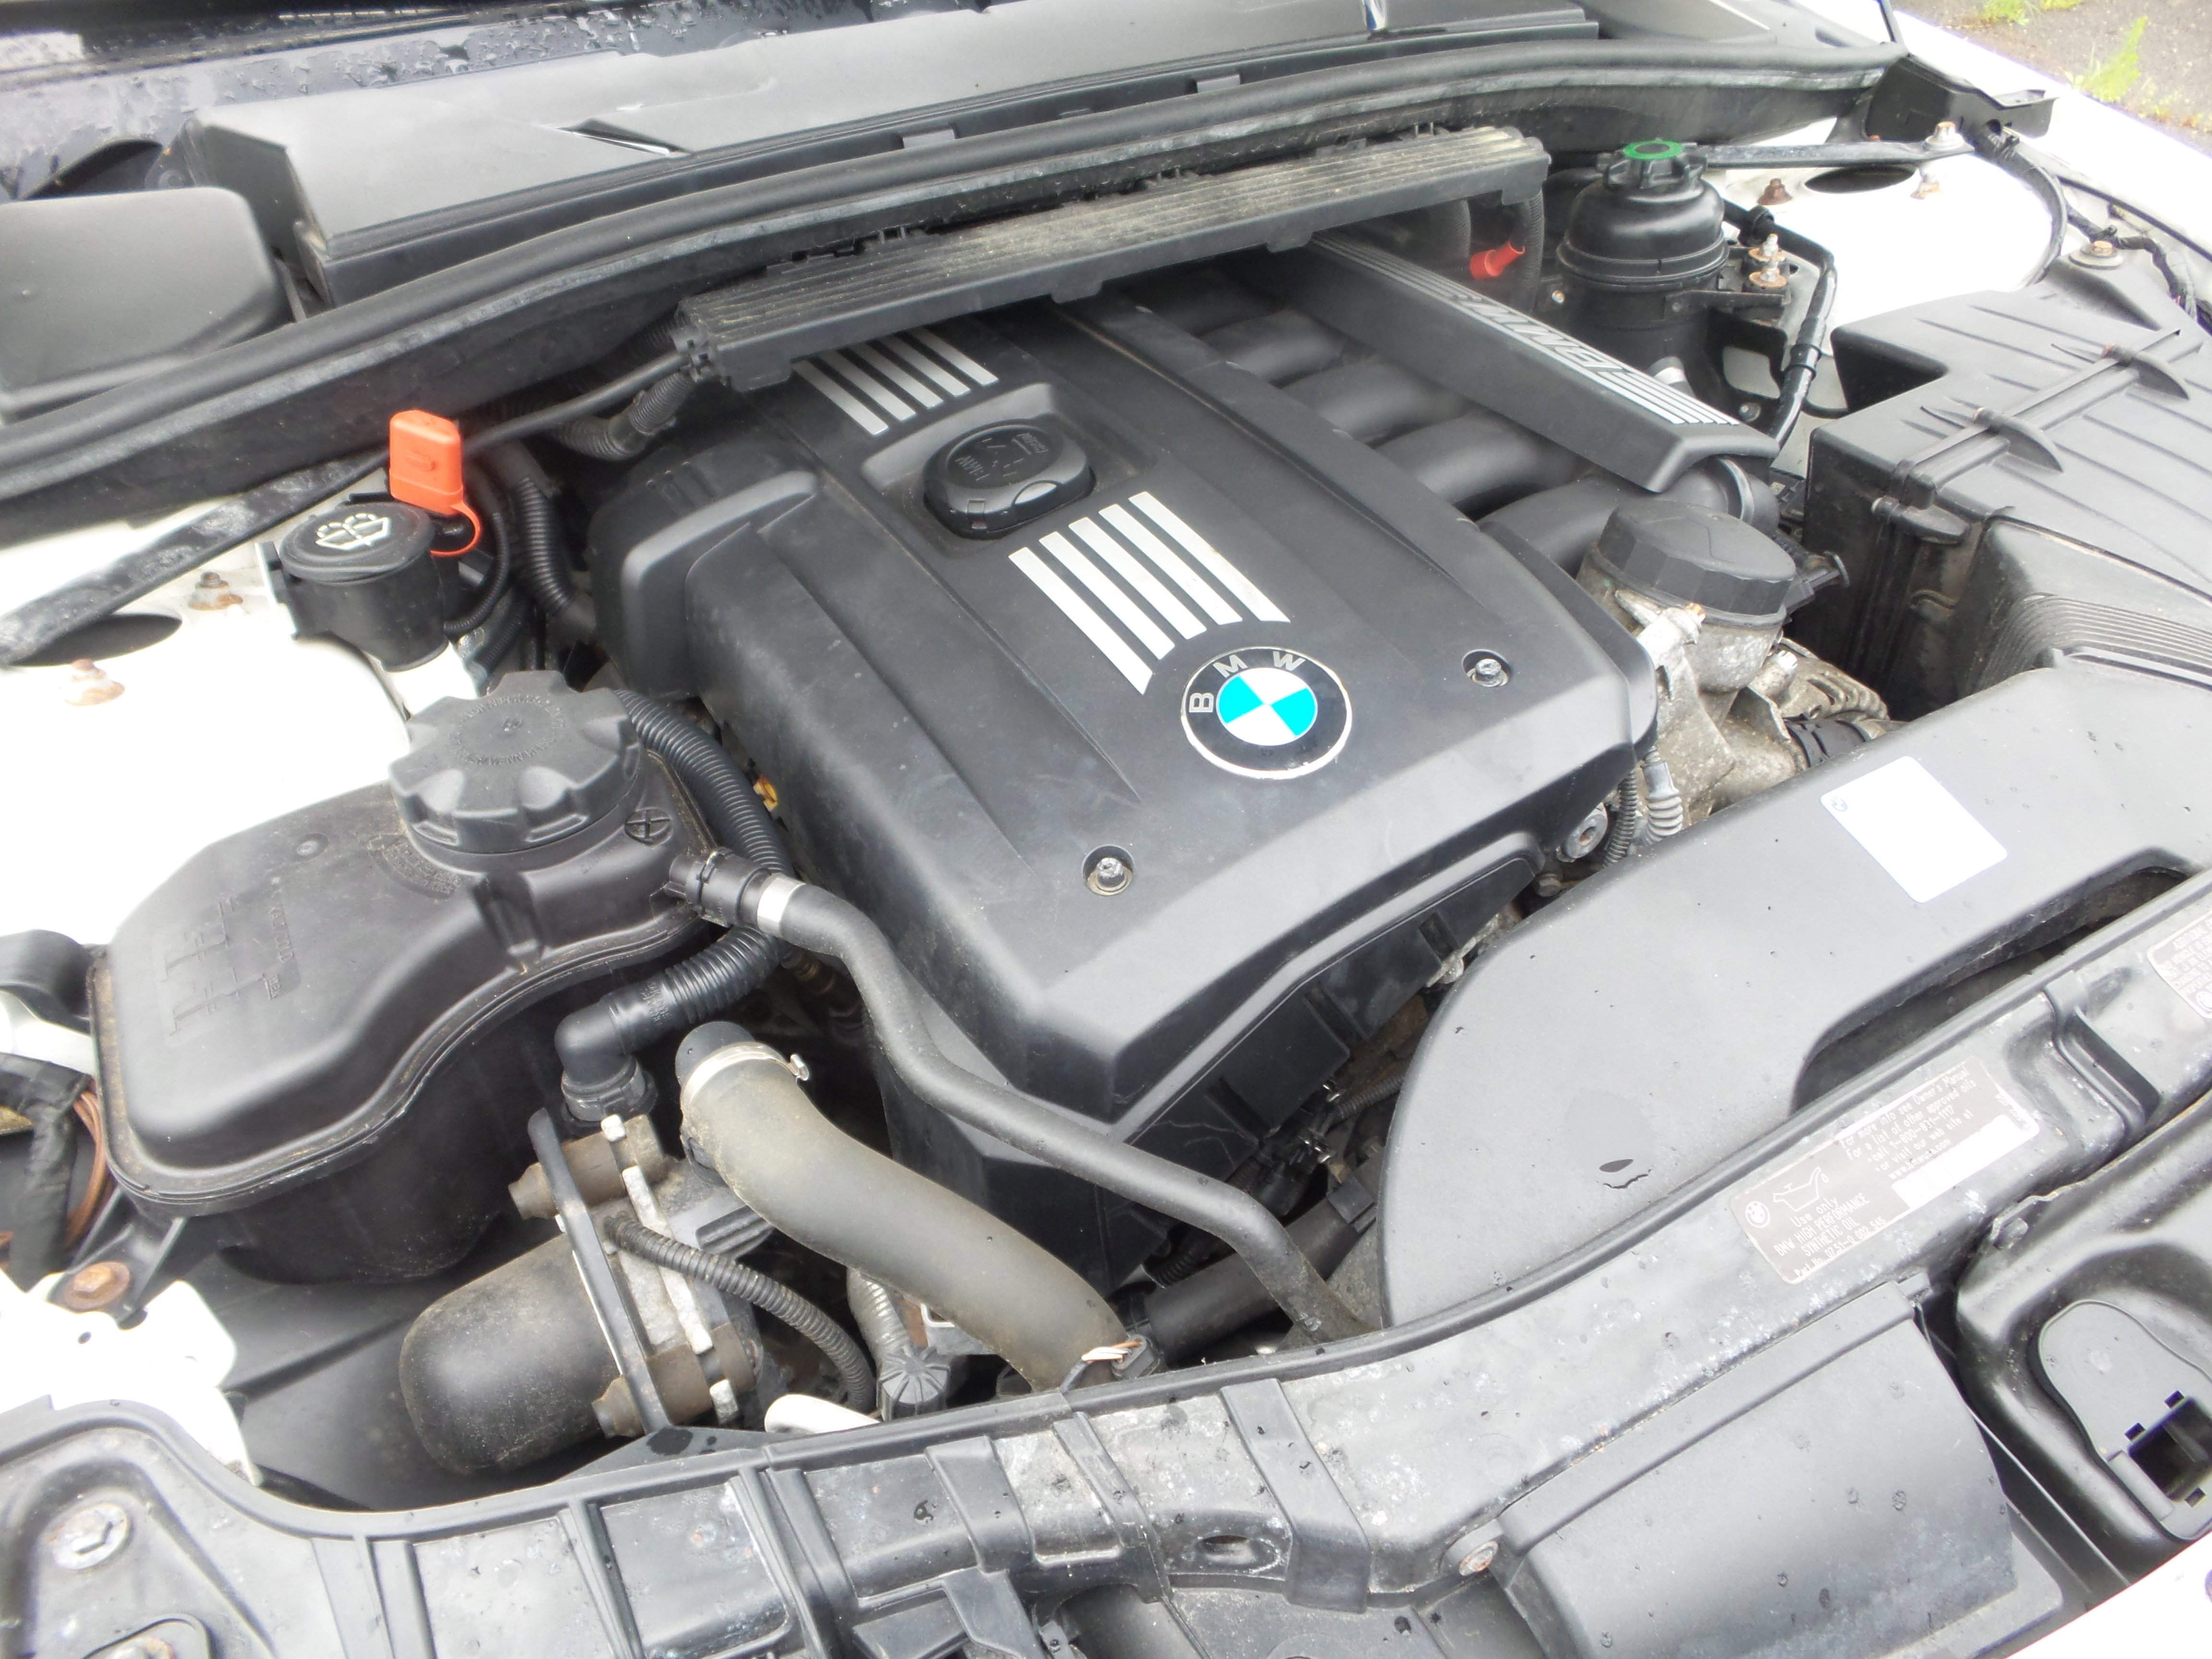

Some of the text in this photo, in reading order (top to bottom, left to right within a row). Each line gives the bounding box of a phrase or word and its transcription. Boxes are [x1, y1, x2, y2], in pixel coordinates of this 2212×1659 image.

[1189, 650, 1306, 713] BMW
[1839, 1069, 1970, 1149] For more info see Owner's Manual
[1846, 1148, 1862, 1160] For
[1871, 1129, 1889, 1144] list
[1891, 1121, 1901, 1134] of
[1904, 1111, 1923, 1127] other
[1926, 1087, 1960, 1113] approved
[1960, 1079, 1976, 1092] oils
[1881, 1109, 1973, 1170] or visit our web site at
[1888, 1139, 1951, 1179] www.bmwusa.com
[1773, 1193, 1870, 1256] BMW HIGH PERFORMANCE
[1790, 1197, 1838, 1227] Use only
[1801, 1217, 1861, 1256] SYNTHETIC OIL
[1794, 1263, 1811, 1277] Part
